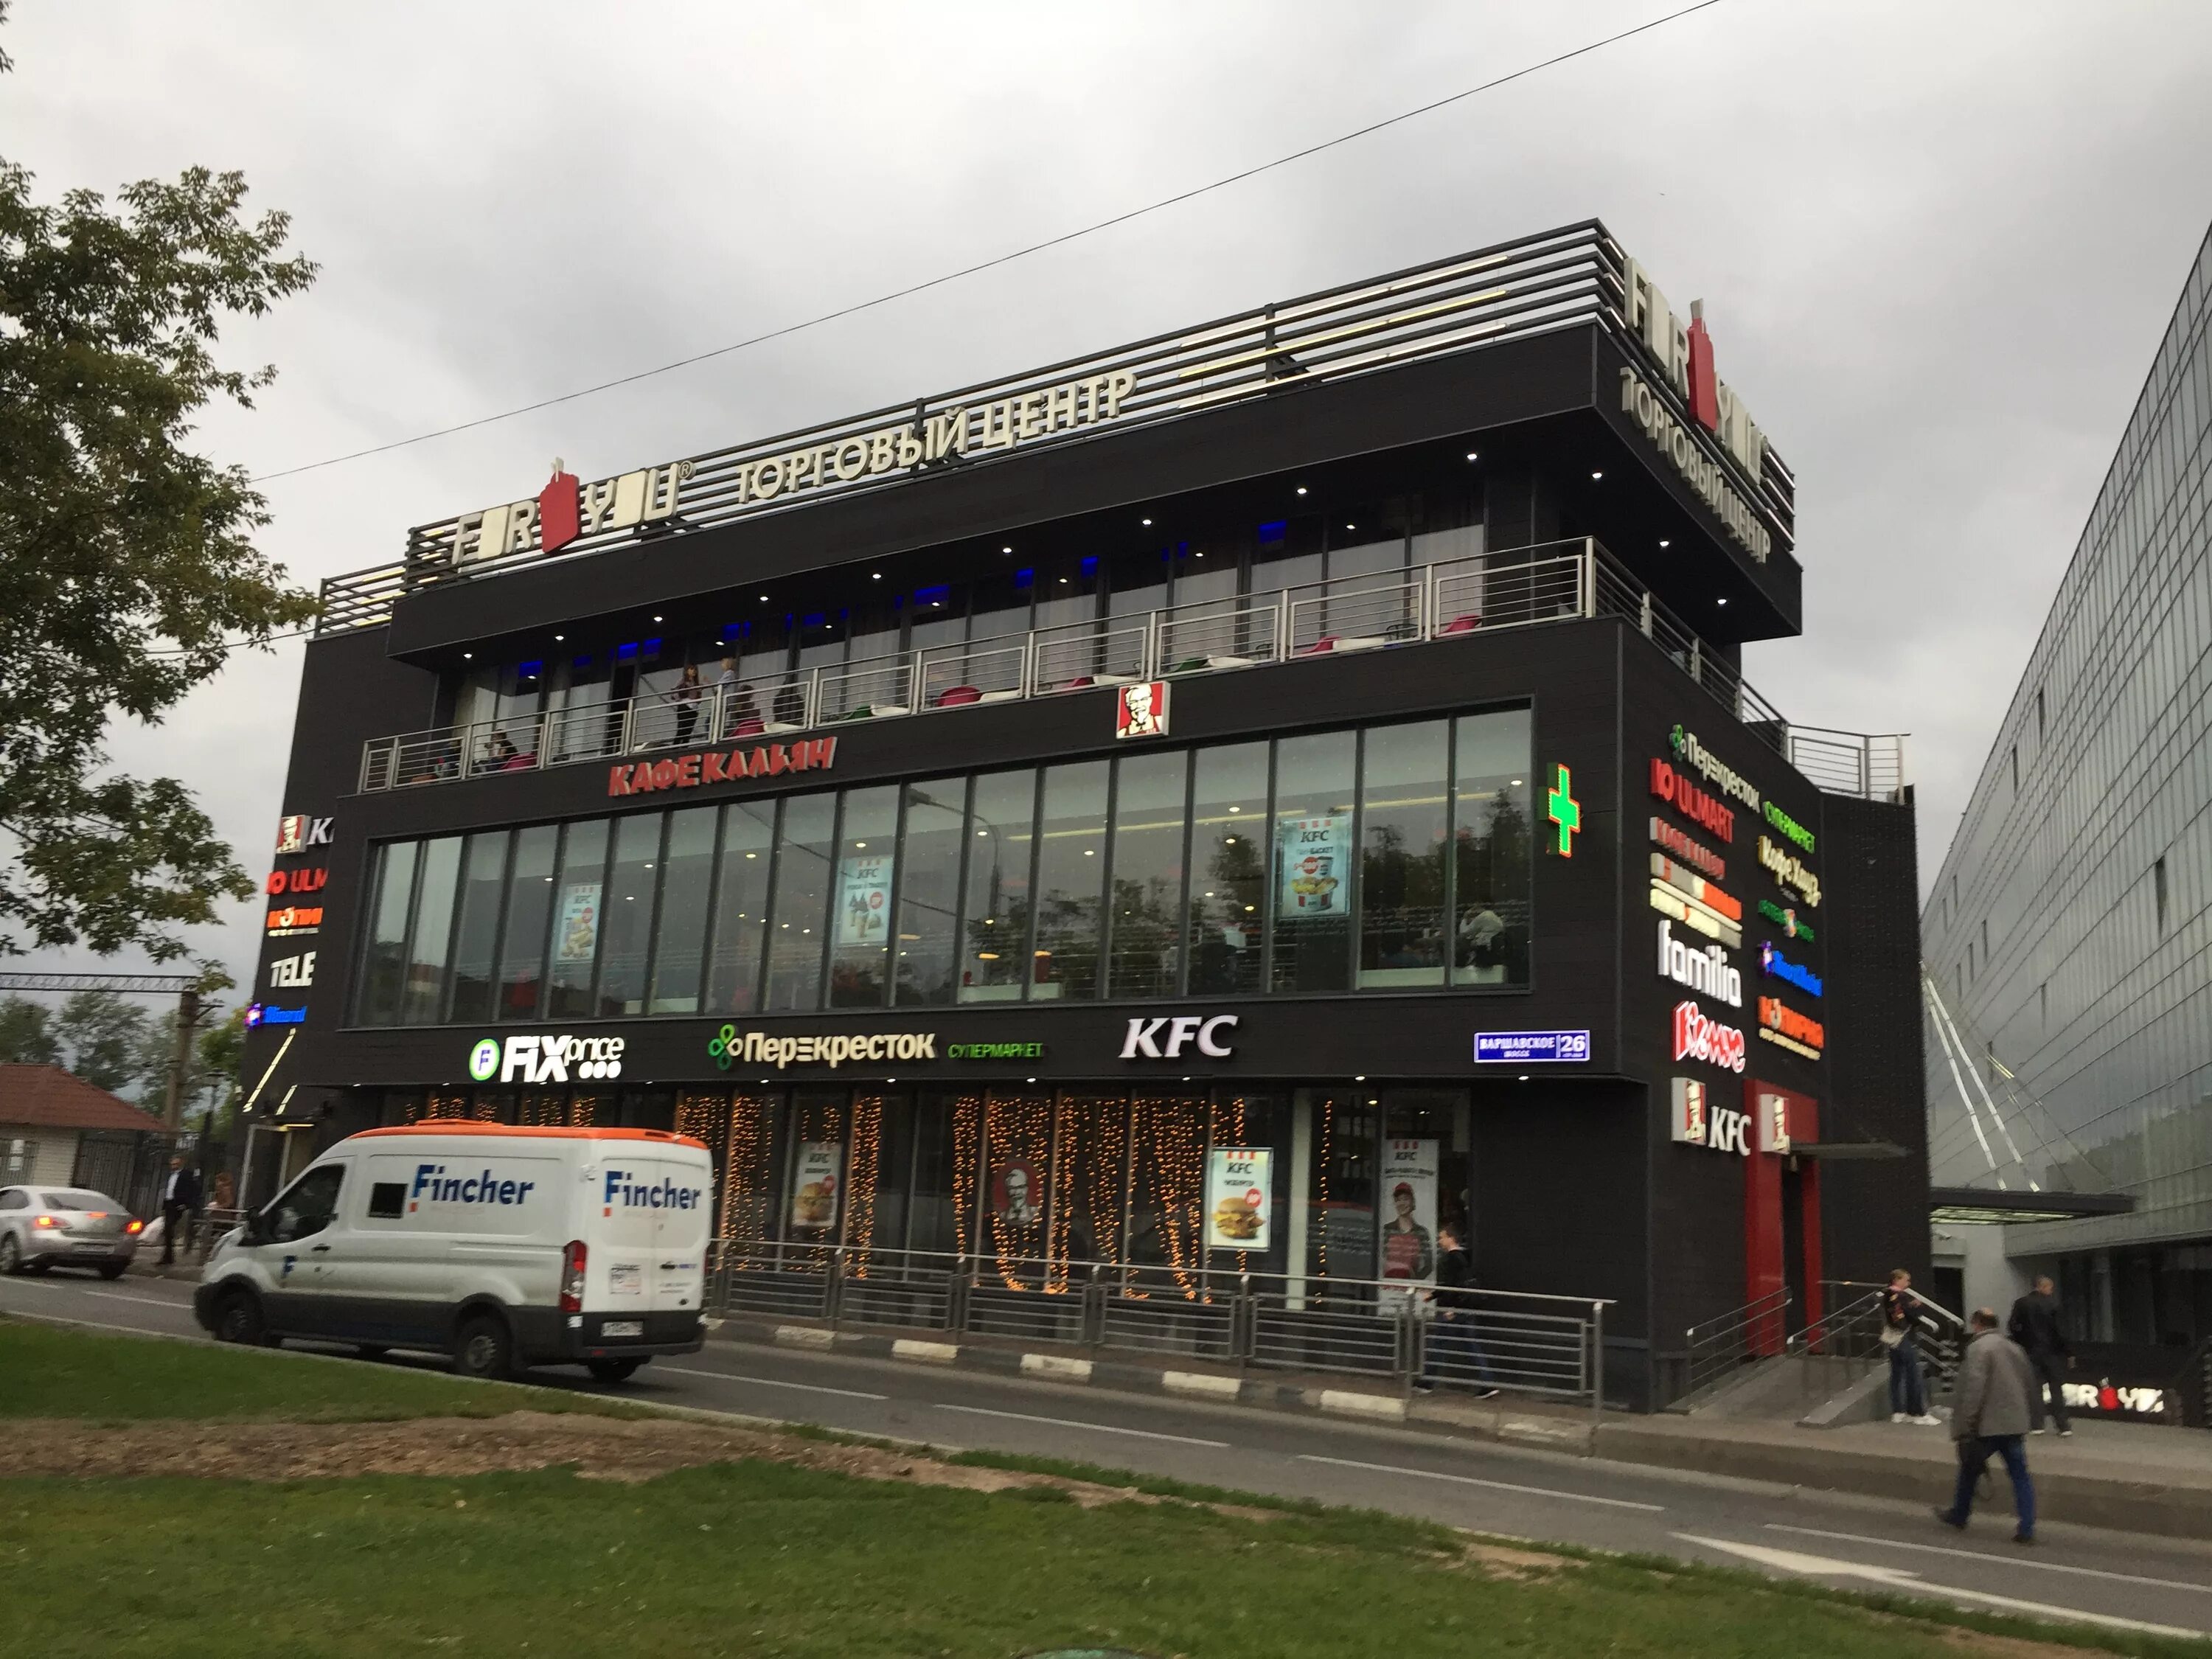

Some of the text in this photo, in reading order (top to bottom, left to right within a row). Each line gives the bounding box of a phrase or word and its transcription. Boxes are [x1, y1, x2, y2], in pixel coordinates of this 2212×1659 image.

[737, 369, 1138, 504] ТОРГОВЫЙ ЦЕНТР
[1620, 366, 1772, 564] ТОРГОВЫЙ ЦЕНТР
[608, 736, 838, 797] КАФЕ КАЛЬЯН
[1674, 774, 1735, 844] ULMART
[307, 816, 335, 845] K
[1301, 830, 1330, 843] KFC
[270, 950, 317, 988] TELE
[1657, 919, 1743, 1008] familia
[744, 1032, 1044, 1070] Перекресток СУПЕРМАРКЕТ
[1118, 1015, 1239, 1059] KFC
[1479, 1035, 1586, 1052] ВАРШАВСКОЕ 26
[1708, 1105, 1752, 1156] KFC
[410, 1164, 536, 1205] Fincher
[1226, 1162, 1254, 1175] KFC
[603, 1170, 703, 1210] Fincher
